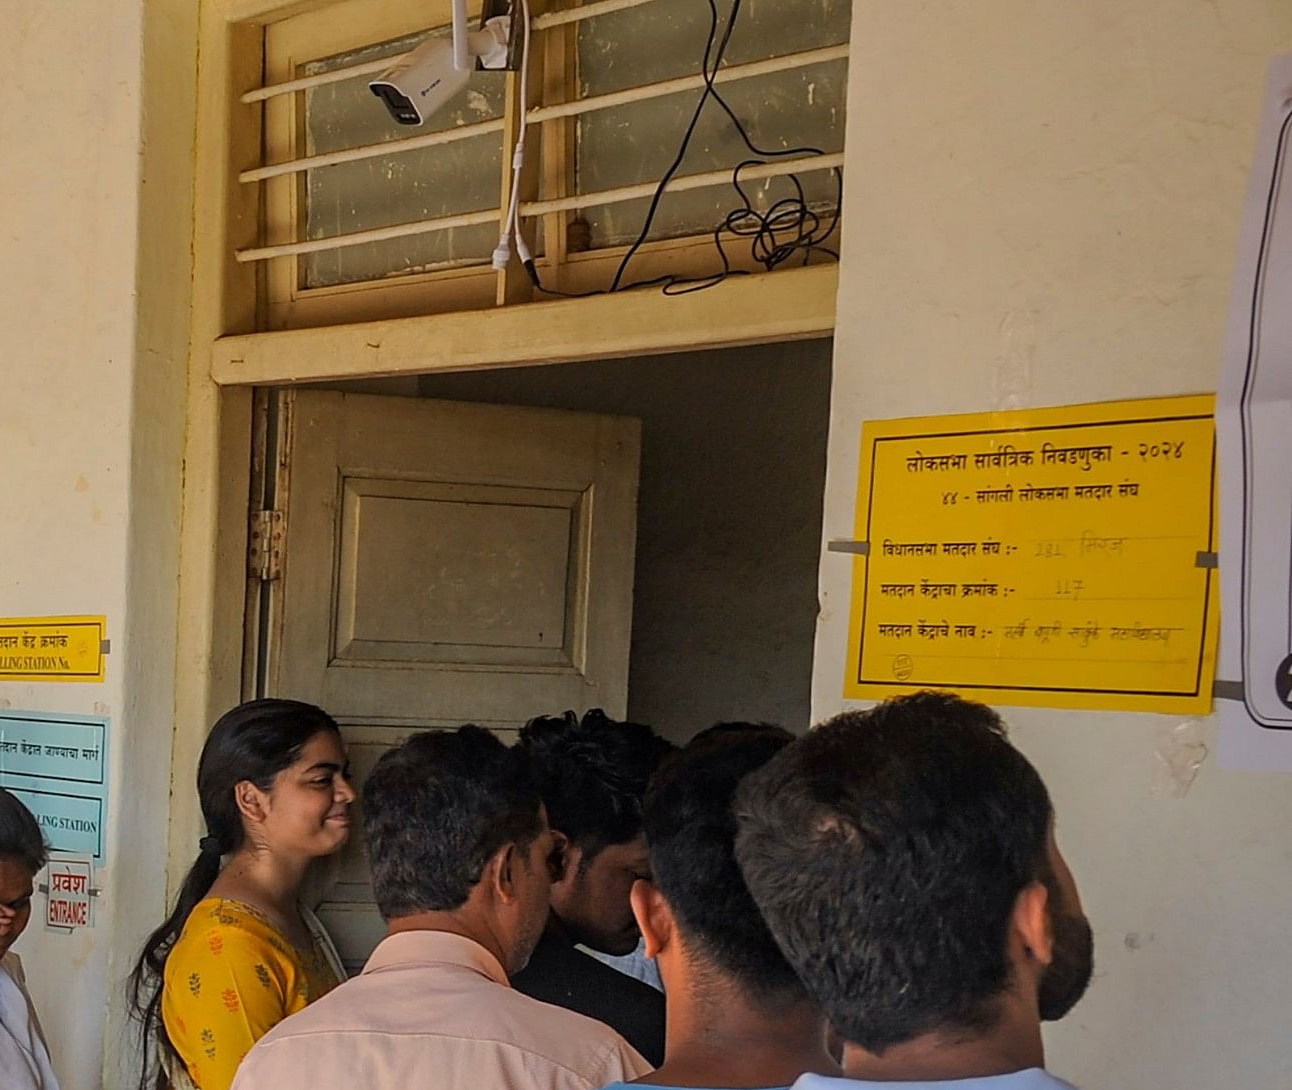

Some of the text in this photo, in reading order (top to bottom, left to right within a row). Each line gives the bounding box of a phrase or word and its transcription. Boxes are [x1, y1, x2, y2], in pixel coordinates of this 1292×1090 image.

[906, 451, 967, 472] लोकसभा
[974, 445, 1034, 469] सार्वत्रिक
[1042, 442, 1113, 471] निवडणुका
[1139, 441, 1184, 462] २०२४
[942, 491, 958, 505] ४४
[975, 484, 1013, 503] सांगली
[1018, 483, 1069, 502] लोकसभा
[1074, 485, 1113, 501] मतदार
[1118, 478, 1139, 497] संघ
[883, 539, 937, 556] विधानसभा
[942, 543, 977, 558] मतदार
[982, 537, 1000, 555] संघ
[881, 584, 915, 598] मतदान
[920, 579, 956, 599] केंद्राचा
[962, 578, 998, 597] क्रमांक
[40, 630, 68, 648] क्रमांक
[879, 624, 912, 639] मतदान
[917, 619, 949, 640] केंद्राचे
[955, 625, 977, 638] नाव
[24, 656, 57, 670] STATION
[82, 745, 99, 761] मार्ग
[59, 818, 97, 833] STATION
[52, 866, 87, 895] प्रवेश
[50, 899, 87, 925] ENTRANCE
